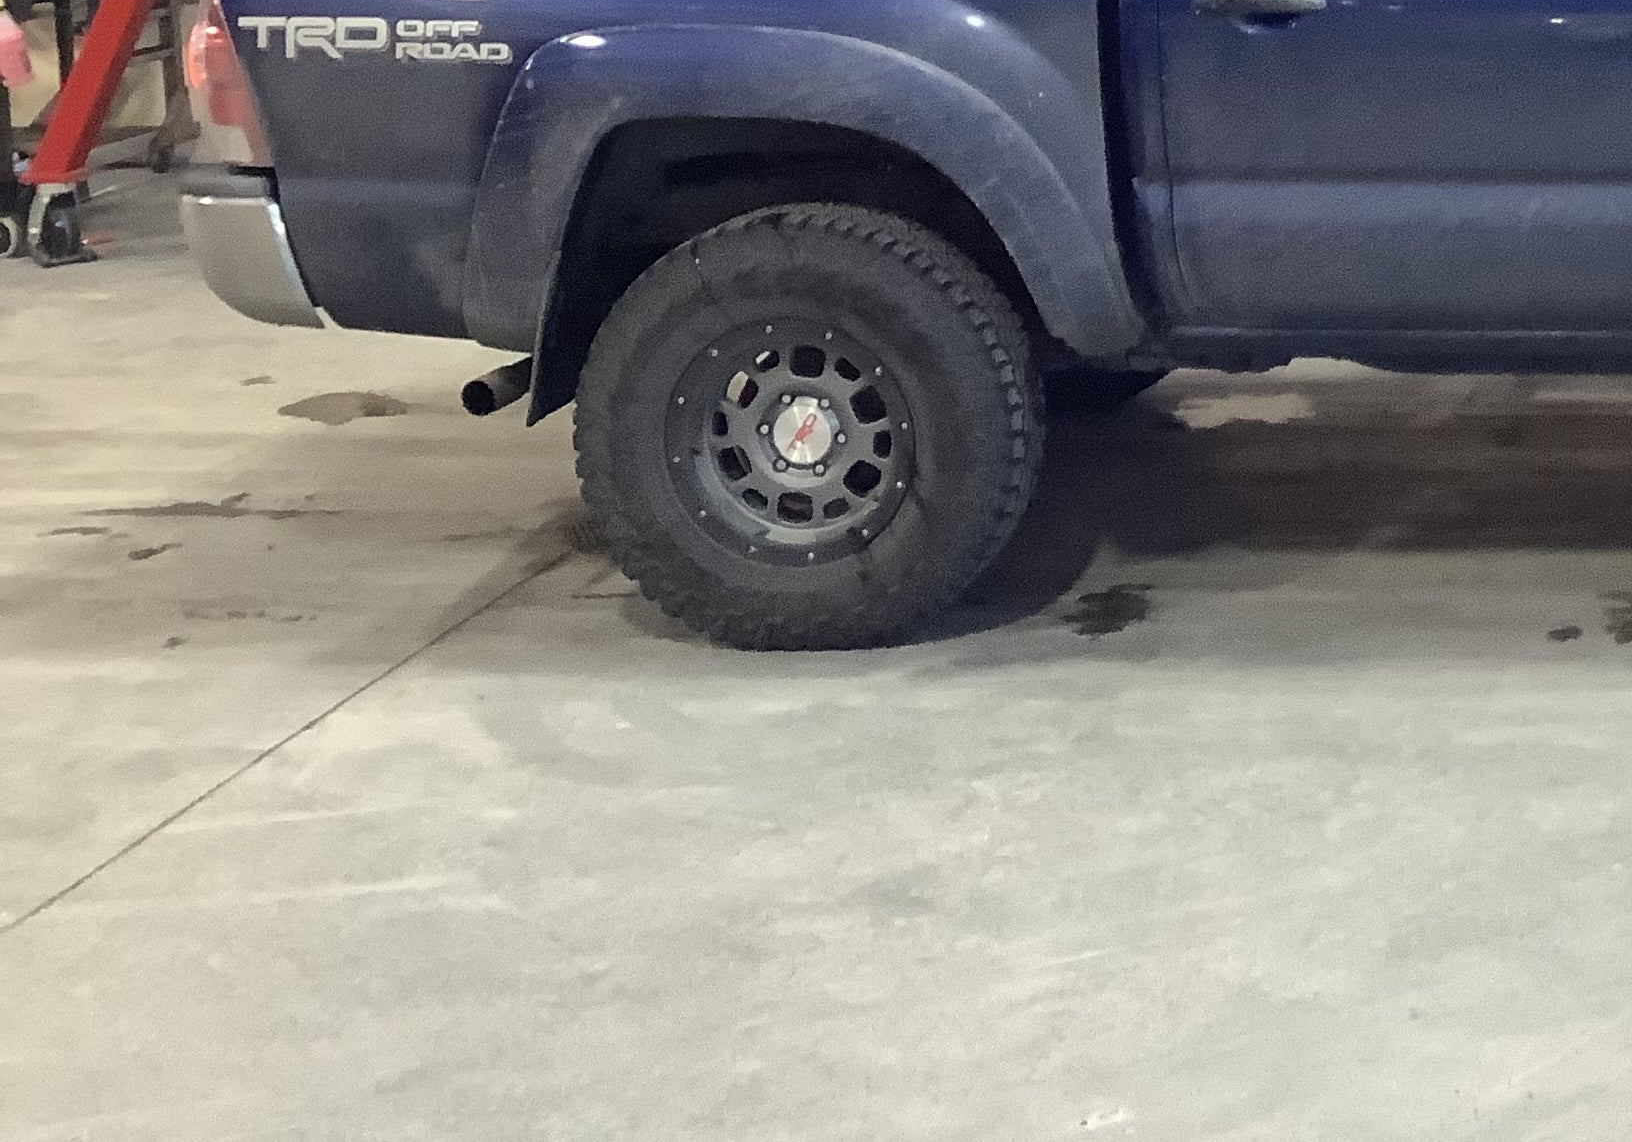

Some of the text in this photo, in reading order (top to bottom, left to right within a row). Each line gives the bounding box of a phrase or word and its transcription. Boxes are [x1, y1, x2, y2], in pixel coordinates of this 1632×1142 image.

[238, 16, 389, 59] TRD
[396, 20, 481, 38] OFF
[396, 42, 512, 62] ROAD
